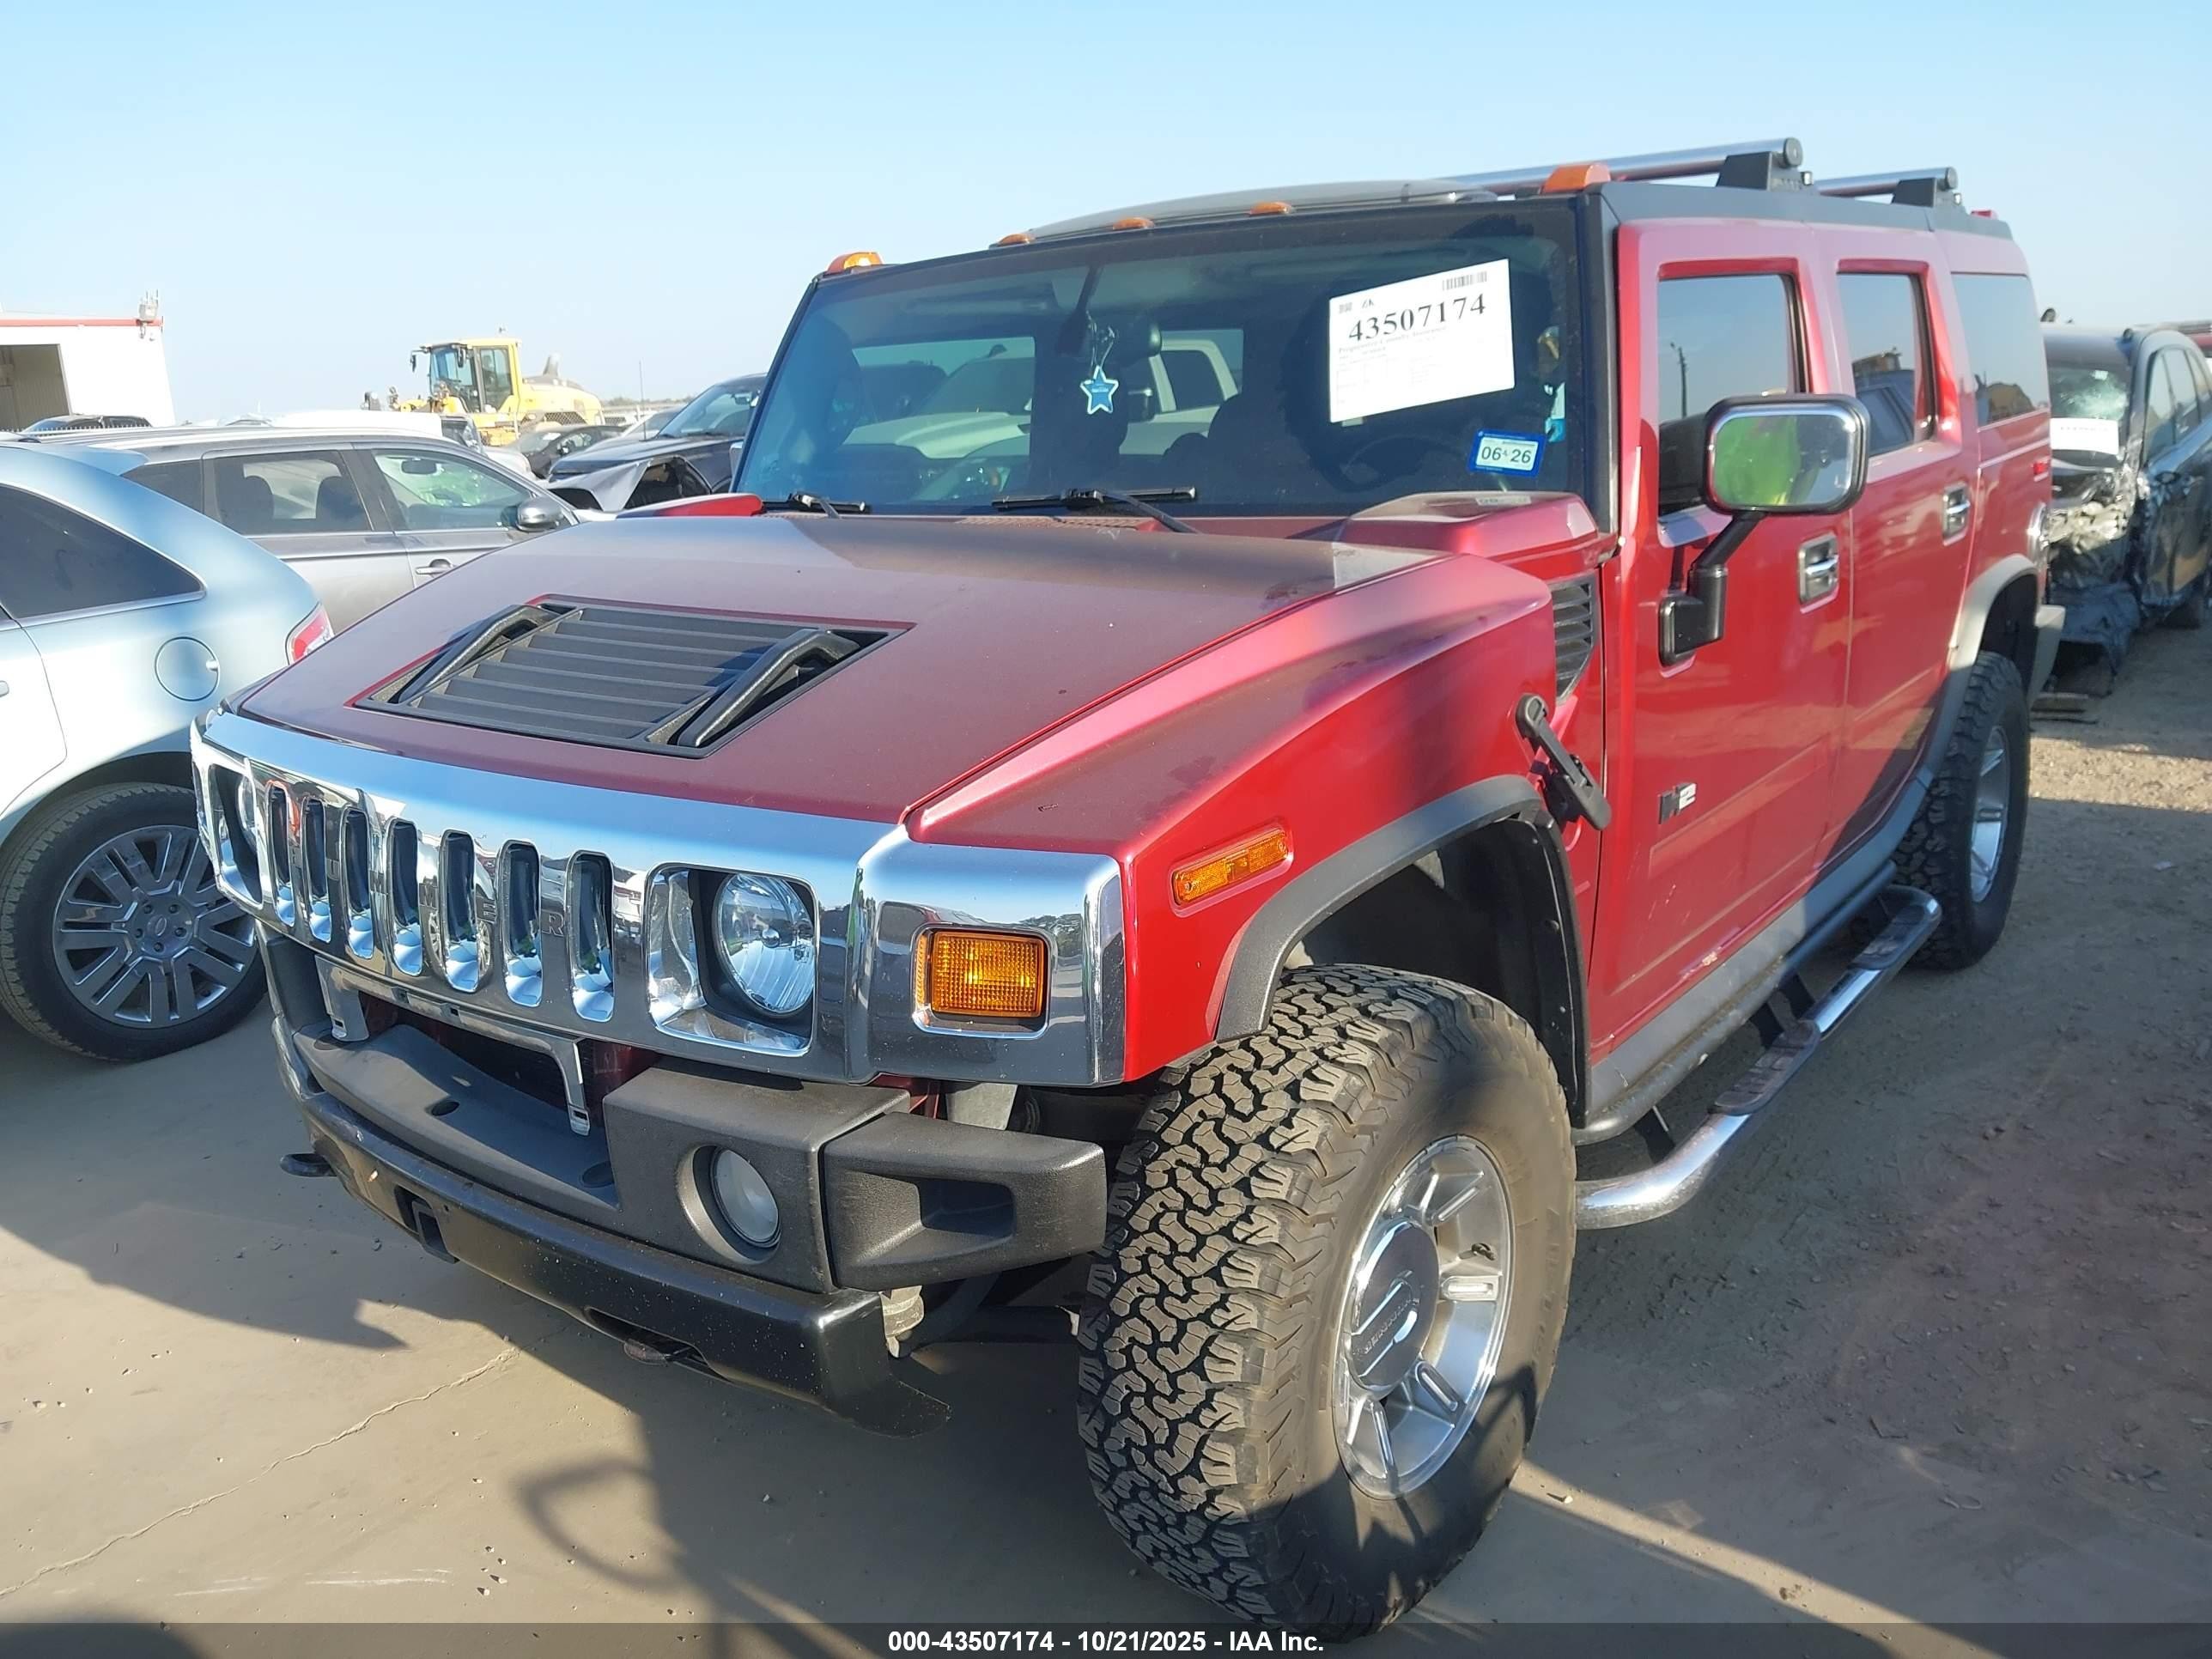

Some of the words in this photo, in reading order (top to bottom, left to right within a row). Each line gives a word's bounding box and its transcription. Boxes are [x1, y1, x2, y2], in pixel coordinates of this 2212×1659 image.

[1348, 293, 1486, 342] 43507174
[1481, 446, 1502, 461] 06
[1510, 449, 1532, 465] 26
[1656, 782, 1697, 824] H2
